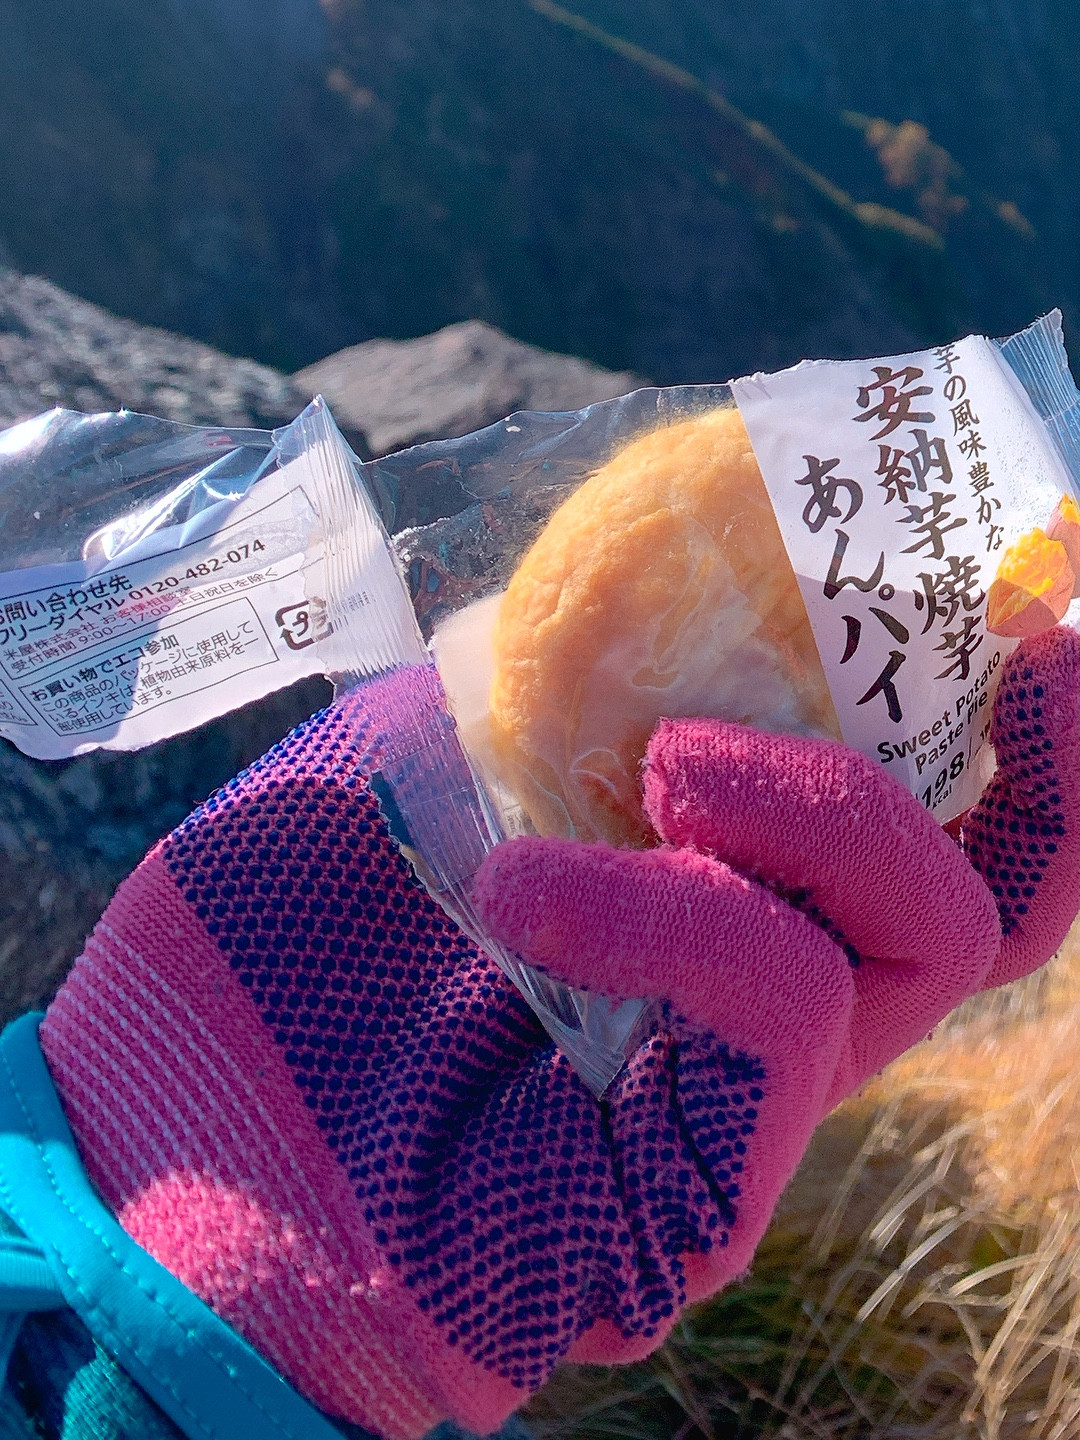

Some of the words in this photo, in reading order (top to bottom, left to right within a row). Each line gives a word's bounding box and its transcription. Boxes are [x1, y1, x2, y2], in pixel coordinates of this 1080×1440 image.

[852, 366, 986, 681] 安納芋焼芋
[128, 539, 266, 601] 0120-482-074
[11, 640, 77, 673] 受付時間
[29, 633, 180, 702] お買い物でエコ参加
[41, 620, 255, 713] この商品のパッケージに使用して
[56, 684, 172, 732] 部使用しています。
[877, 710, 951, 763] Sweet
[955, 651, 1000, 717] Potato
[915, 722, 964, 776] Paste
